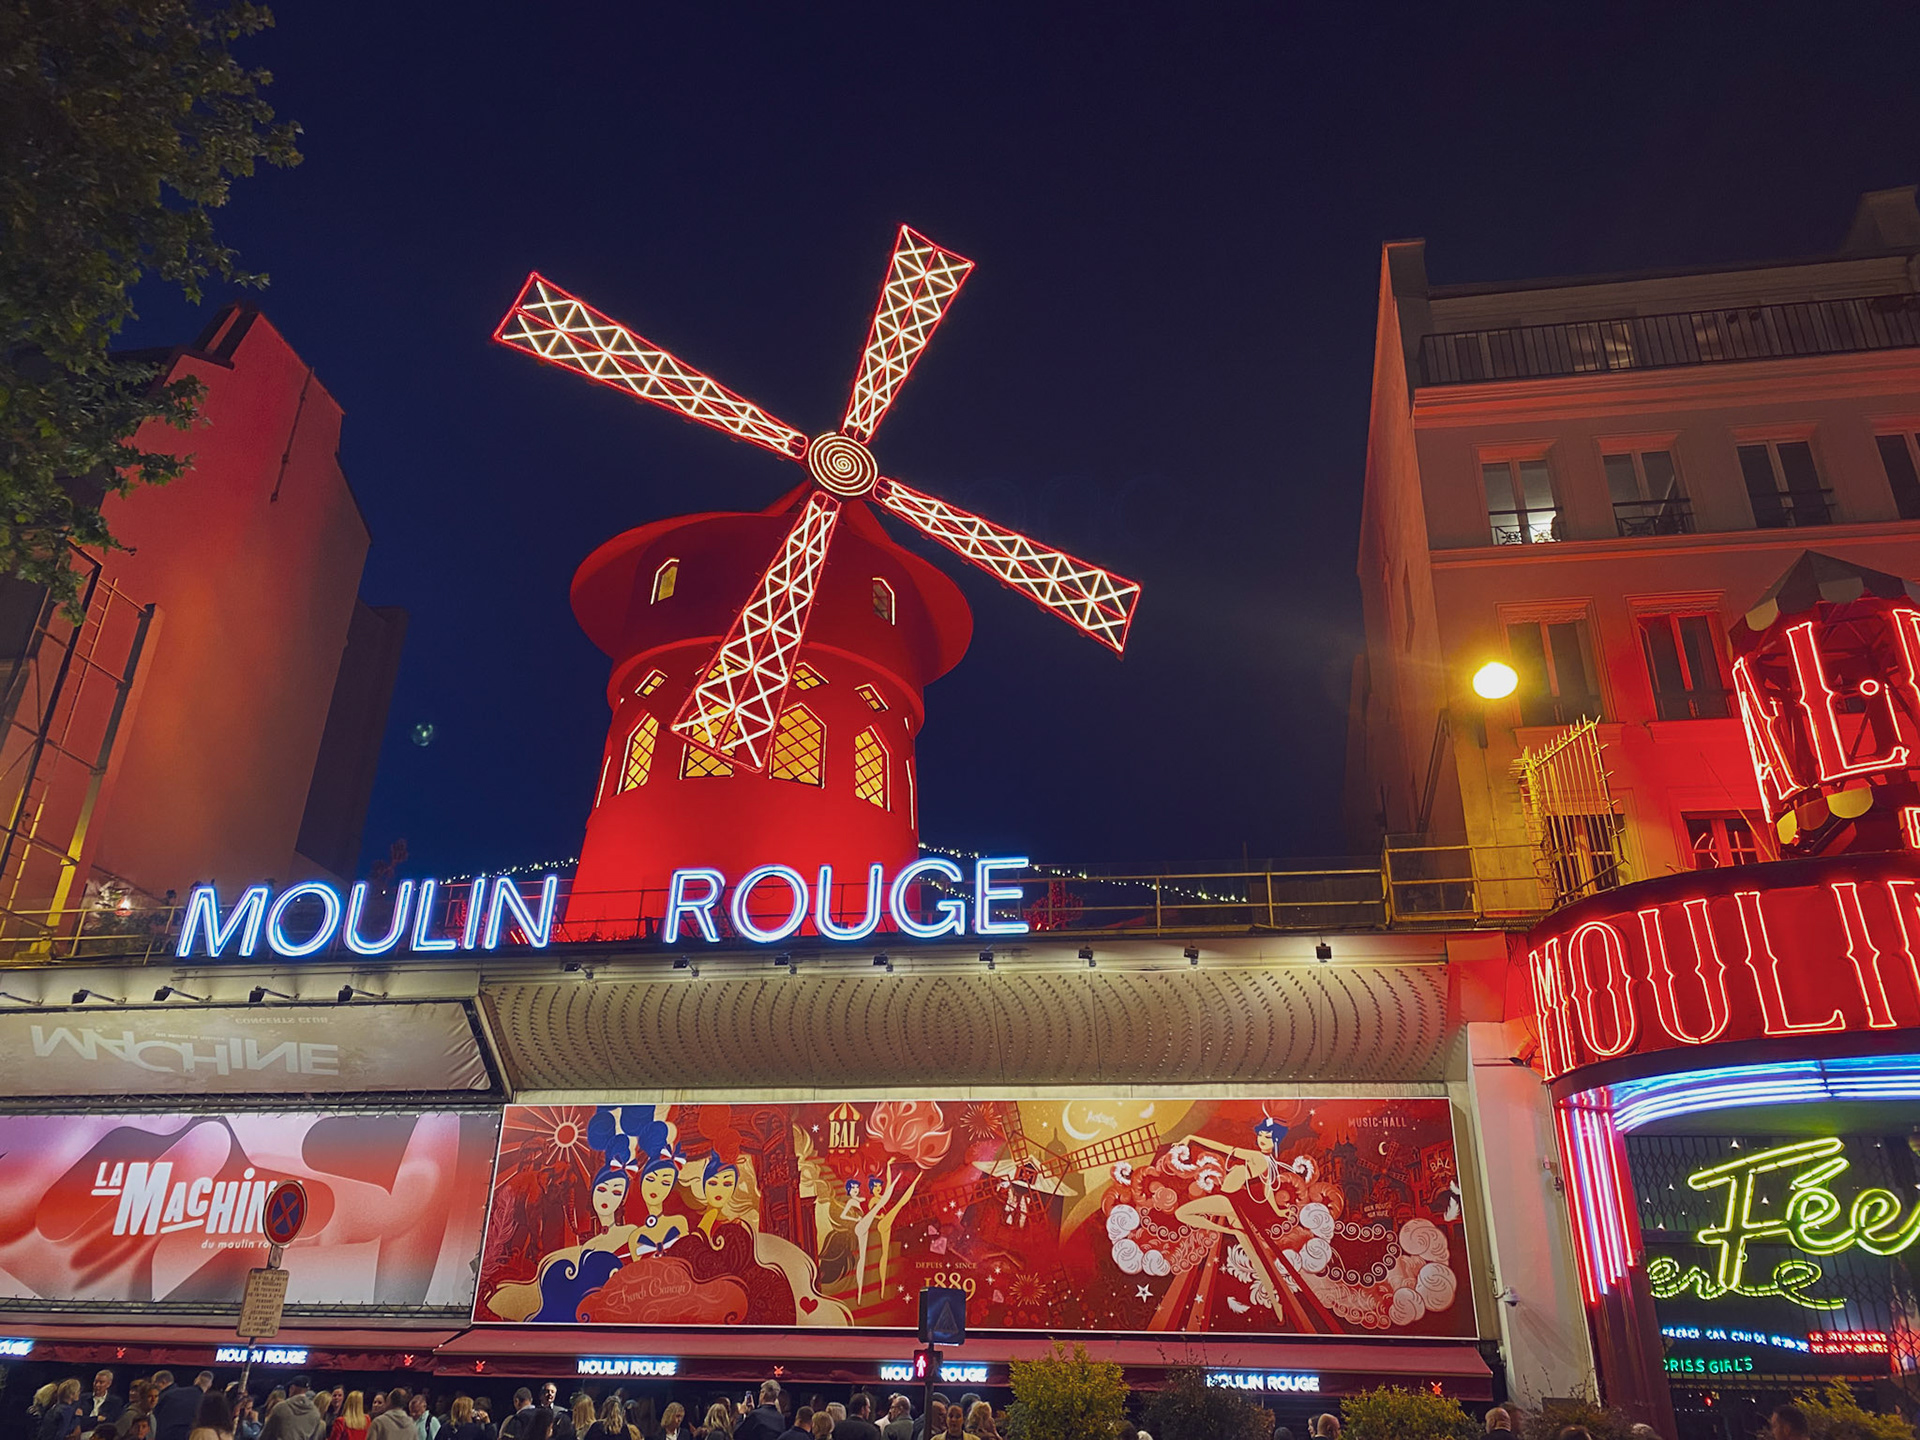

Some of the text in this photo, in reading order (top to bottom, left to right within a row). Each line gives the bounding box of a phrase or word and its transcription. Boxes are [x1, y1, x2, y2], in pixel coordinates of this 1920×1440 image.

[175, 855, 1031, 959] MOULIN ROUGE
[1347, 1117, 1407, 1128] MUSIC-HALL
[828, 1121, 860, 1149] BAL
[1430, 1158, 1451, 1173] BAL
[94, 1162, 124, 1187] LA
[112, 1162, 276, 1236] MACHIN
[201, 1239, 215, 1249] du
[218, 1239, 255, 1249] moulin
[264, 1350, 307, 1364] ROUGE
[578, 1360, 676, 1375] MOULIN ROUGE
[881, 1367, 914, 1381] MOU
[1267, 1376, 1320, 1391] ROUGE
